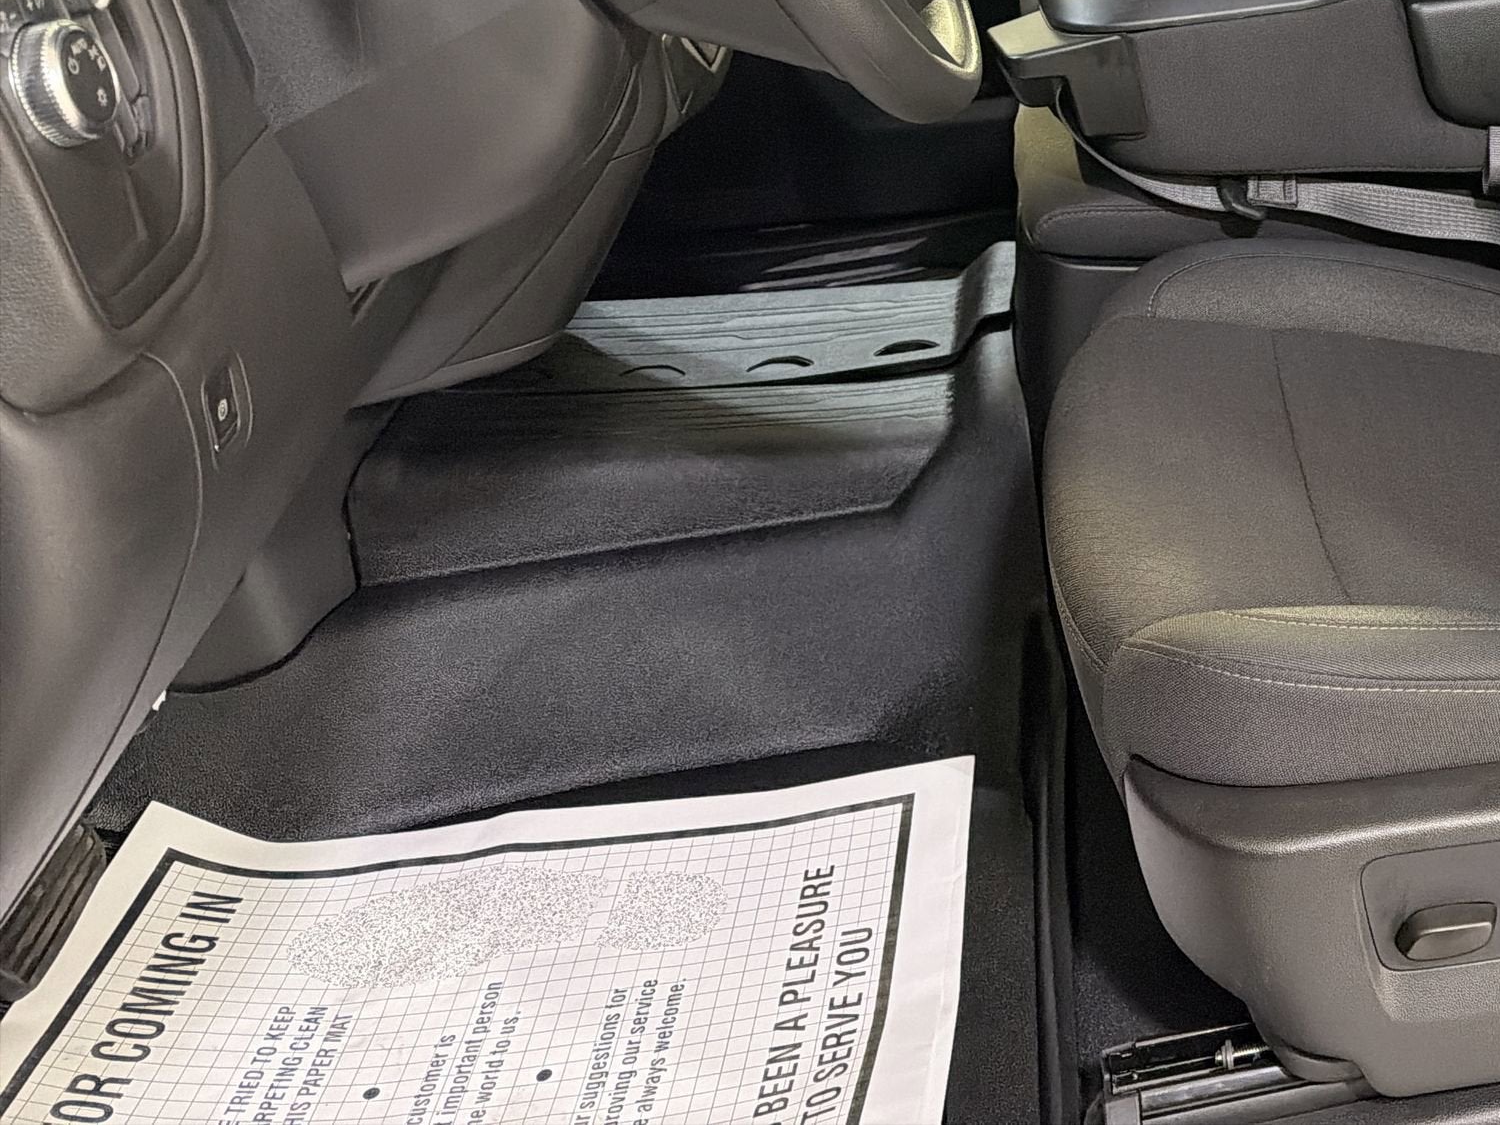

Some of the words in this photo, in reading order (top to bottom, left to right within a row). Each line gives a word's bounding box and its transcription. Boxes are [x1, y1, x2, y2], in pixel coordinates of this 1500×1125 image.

[179, 891, 243, 924] IN
[778, 864, 835, 1006] PLEASURE
[833, 927, 873, 986] YOU
[91, 932, 219, 1062] COMING
[263, 1006, 296, 1040] KEEP
[500, 1011, 521, 1035] us.
[631, 979, 658, 1035] service
[773, 1013, 808, 1031] A
[250, 1046, 277, 1065] TO
[252, 1056, 303, 1125] RPETING
[289, 1006, 328, 1051] CLEAN
[297, 1048, 338, 1096] PAPER
[323, 1015, 353, 1043] MAT
[436, 1038, 483, 1115] important
[472, 981, 503, 1035] person
[489, 1040, 511, 1056] to
[580, 1013, 621, 1109] suggestions
[605, 988, 628, 1009] for
[622, 1040, 642, 1065] our
[636, 1057, 668, 1113] always
[654, 978, 687, 1053] welcome.
[813, 992, 863, 1083] SERVE
[50, 1073, 134, 1125] OR
[224, 1070, 264, 1115] TRIED
[407, 1054, 448, 1125] customer
[434, 1035, 456, 1048] is
[475, 1059, 504, 1105] world
[753, 1042, 803, 1118] BEEN
[801, 1086, 842, 1125] TO
